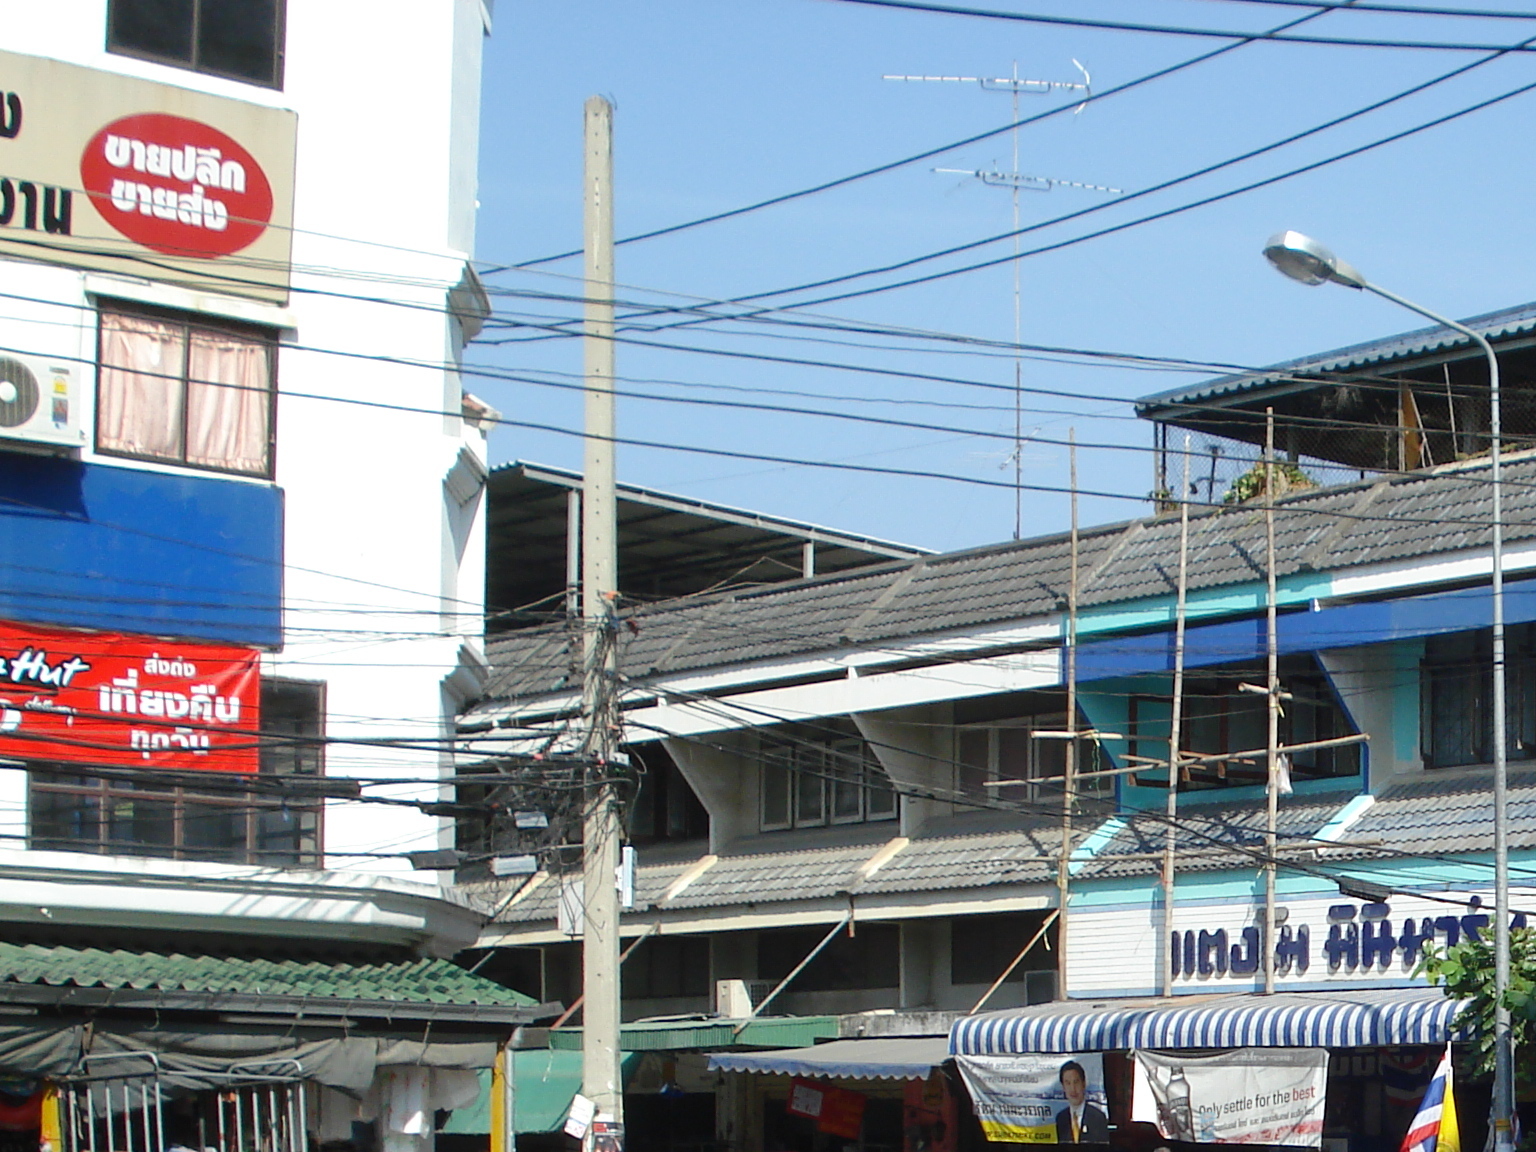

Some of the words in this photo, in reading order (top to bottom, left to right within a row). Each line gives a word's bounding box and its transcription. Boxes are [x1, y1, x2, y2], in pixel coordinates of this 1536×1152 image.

[104, 134, 247, 193] ขายปลีก
[110, 178, 228, 231] ขายส่ง
[10, 646, 91, 688] Hut
[98, 668, 240, 724] เที่ยงคืน
[1223, 1096, 1253, 1116] settle
[1255, 1092, 1271, 1109] for
[1272, 1090, 1291, 1106] the
[1292, 1085, 1316, 1102] best
